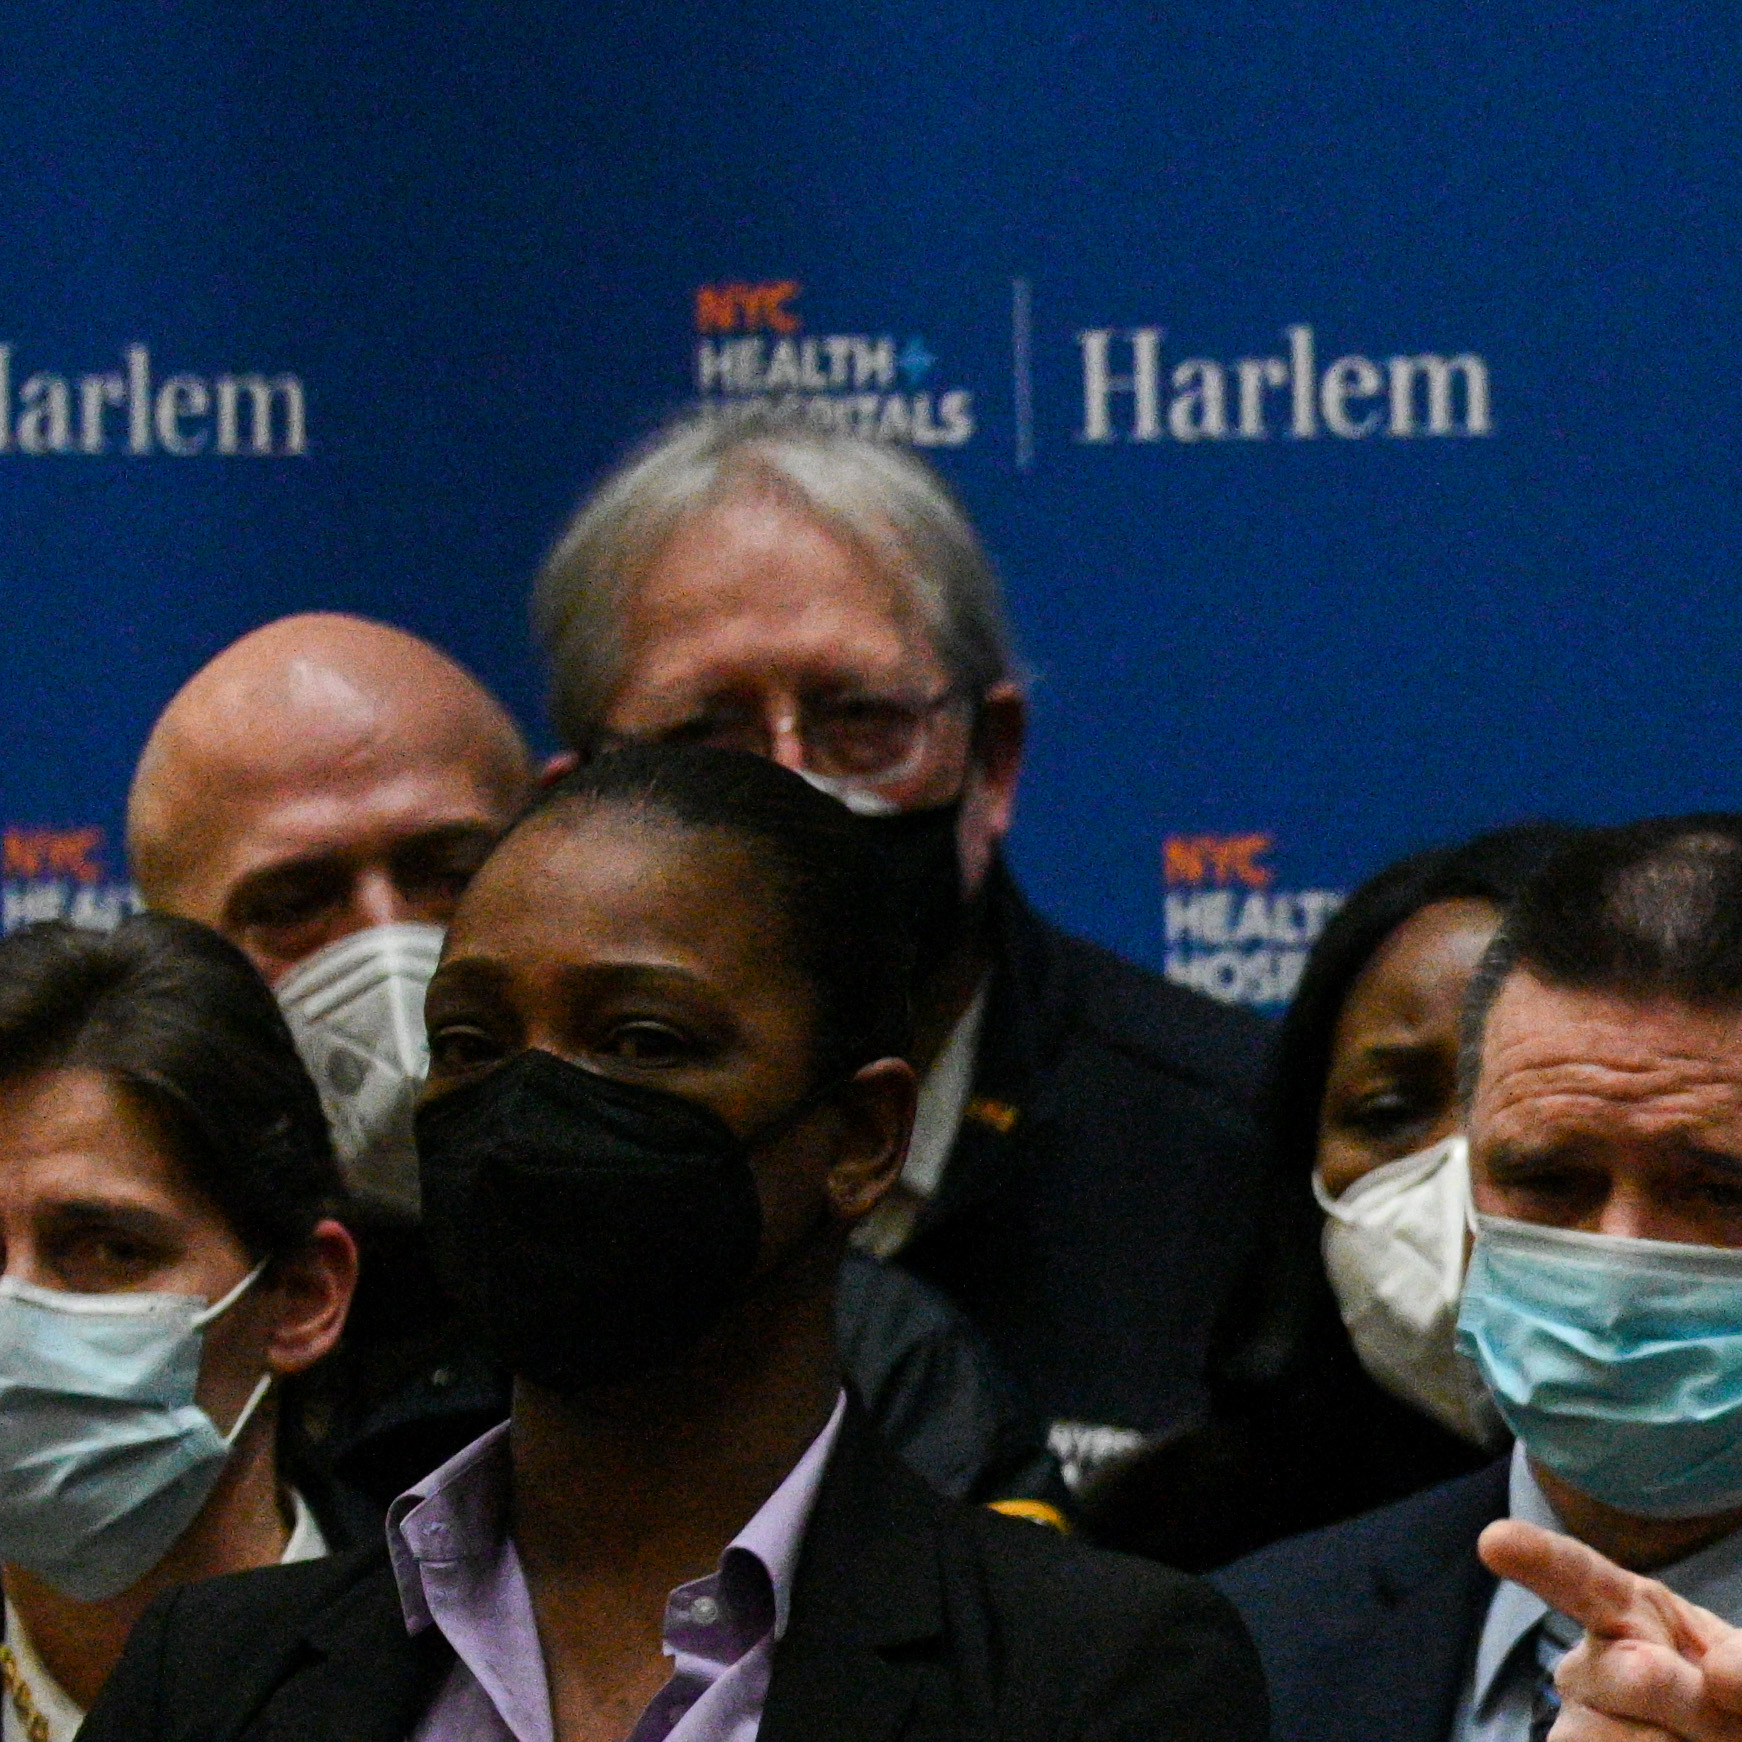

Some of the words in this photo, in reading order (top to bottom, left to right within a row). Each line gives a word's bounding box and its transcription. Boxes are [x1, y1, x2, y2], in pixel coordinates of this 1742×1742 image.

[696, 280, 800, 332] NYC
[0, 342, 305, 455] arlem
[1075, 324, 1494, 443] Harlem
[1162, 832, 1274, 885] NYC
